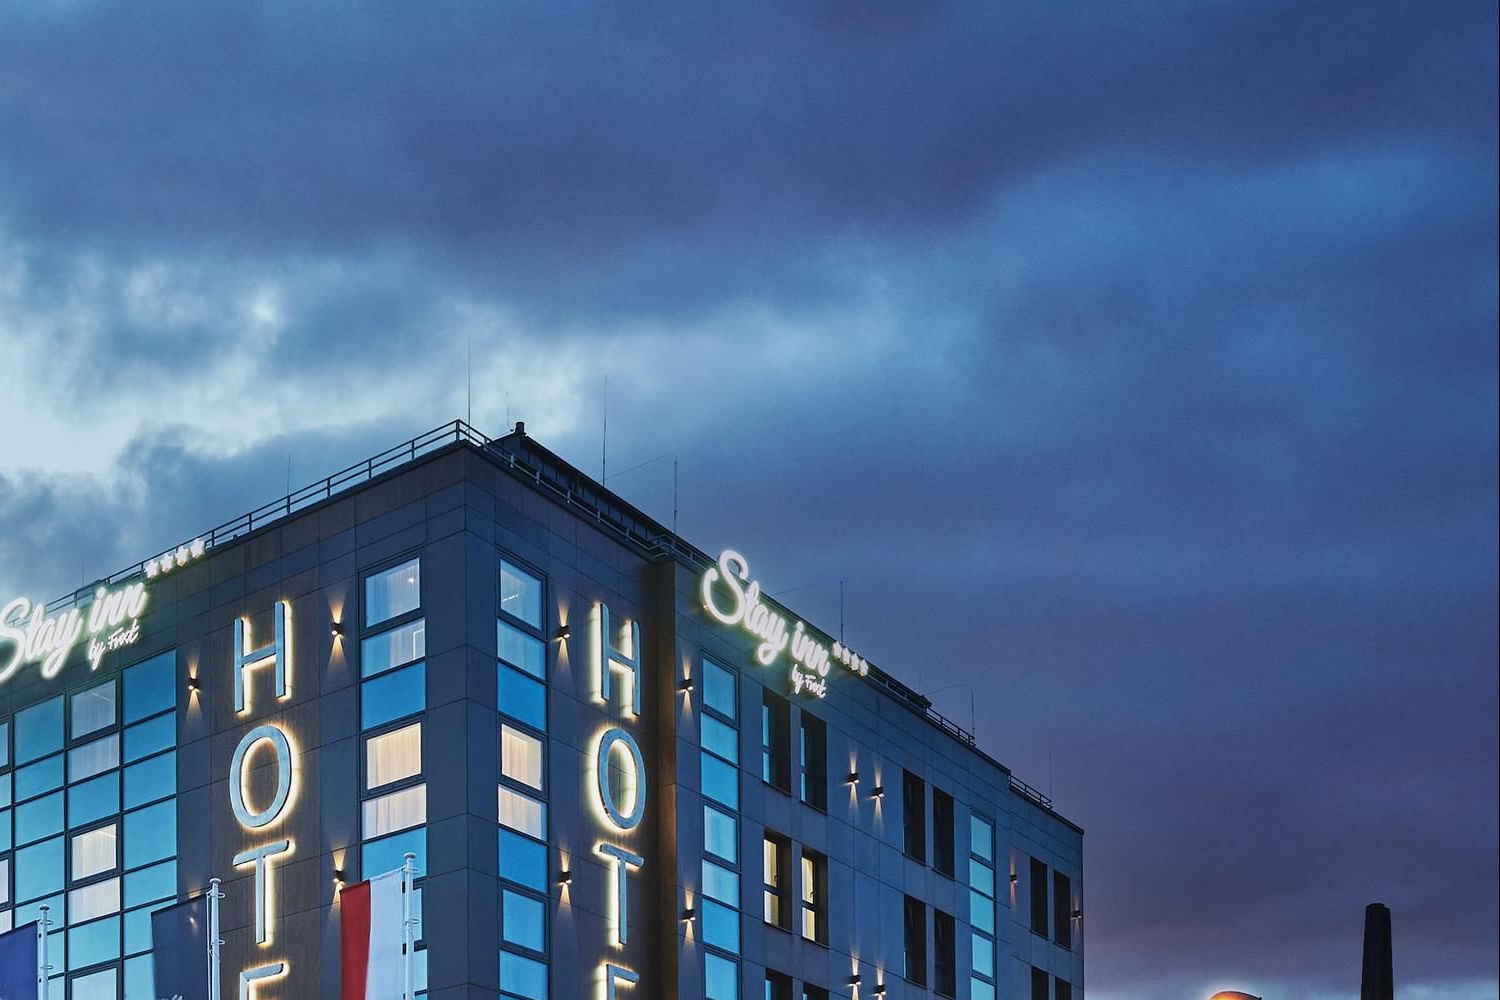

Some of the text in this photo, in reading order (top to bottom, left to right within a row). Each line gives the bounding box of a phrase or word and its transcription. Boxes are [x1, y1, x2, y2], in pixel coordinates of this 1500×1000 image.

[88, 582, 148, 634] inn
[703, 550, 831, 677] Stay inn
[88, 637, 106, 671] by
